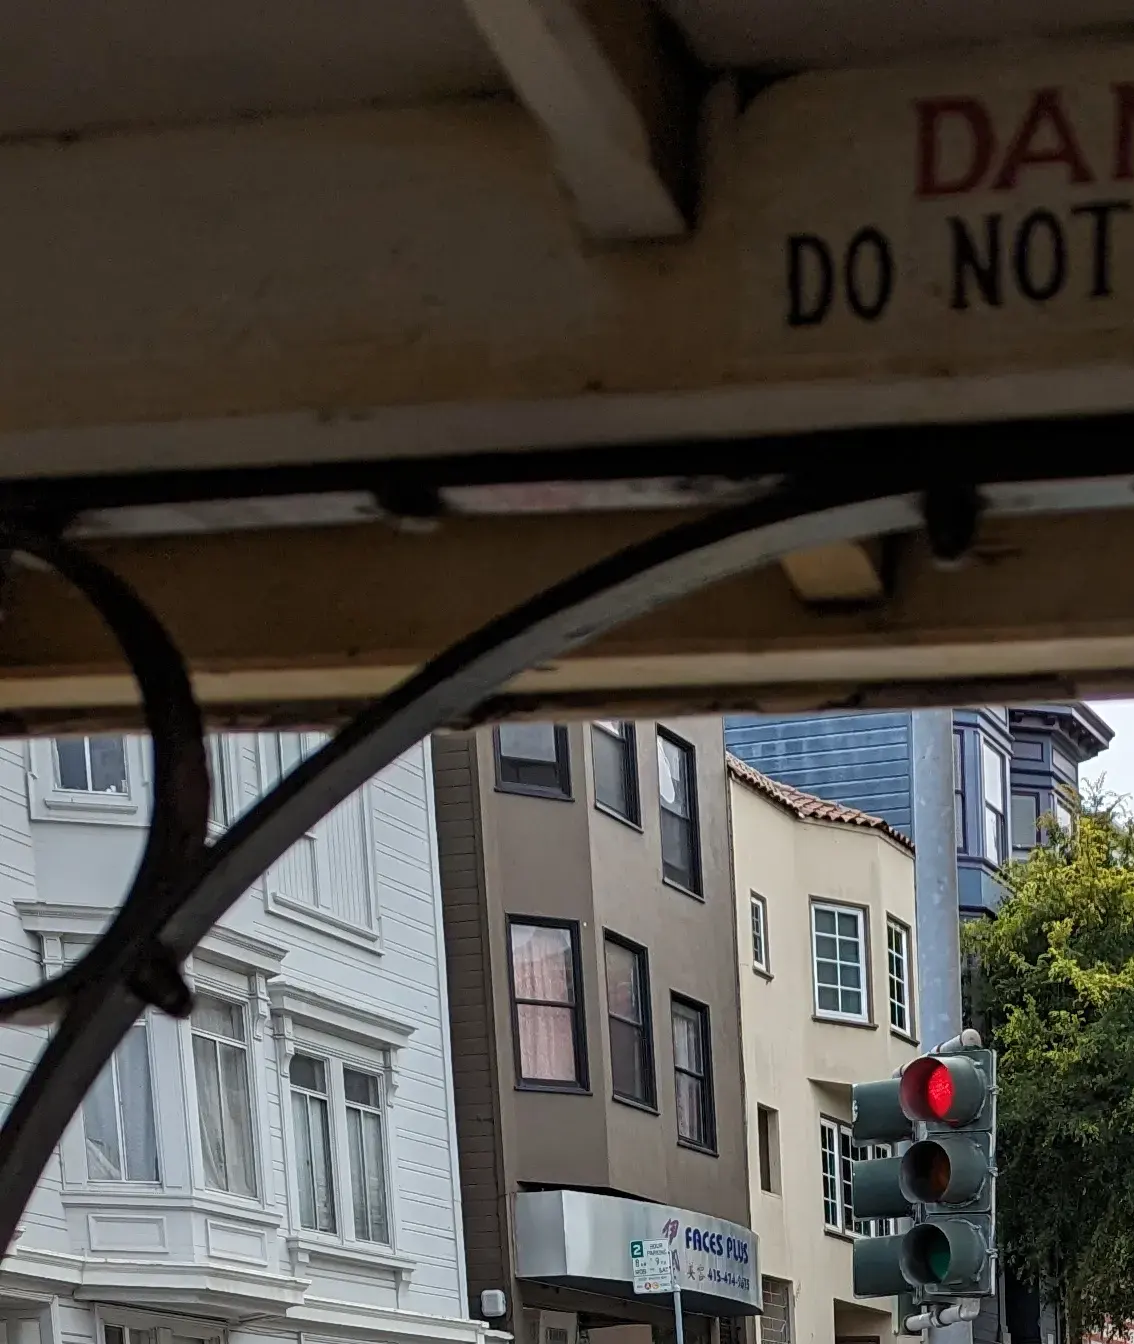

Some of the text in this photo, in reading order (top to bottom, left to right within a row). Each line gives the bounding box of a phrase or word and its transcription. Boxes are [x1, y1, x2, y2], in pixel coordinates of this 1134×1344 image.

[784, 223, 895, 328] DO
[946, 200, 1133, 312] NOT
[632, 1244, 641, 1256] 2
[685, 1227, 749, 1264] FACES PLUS
